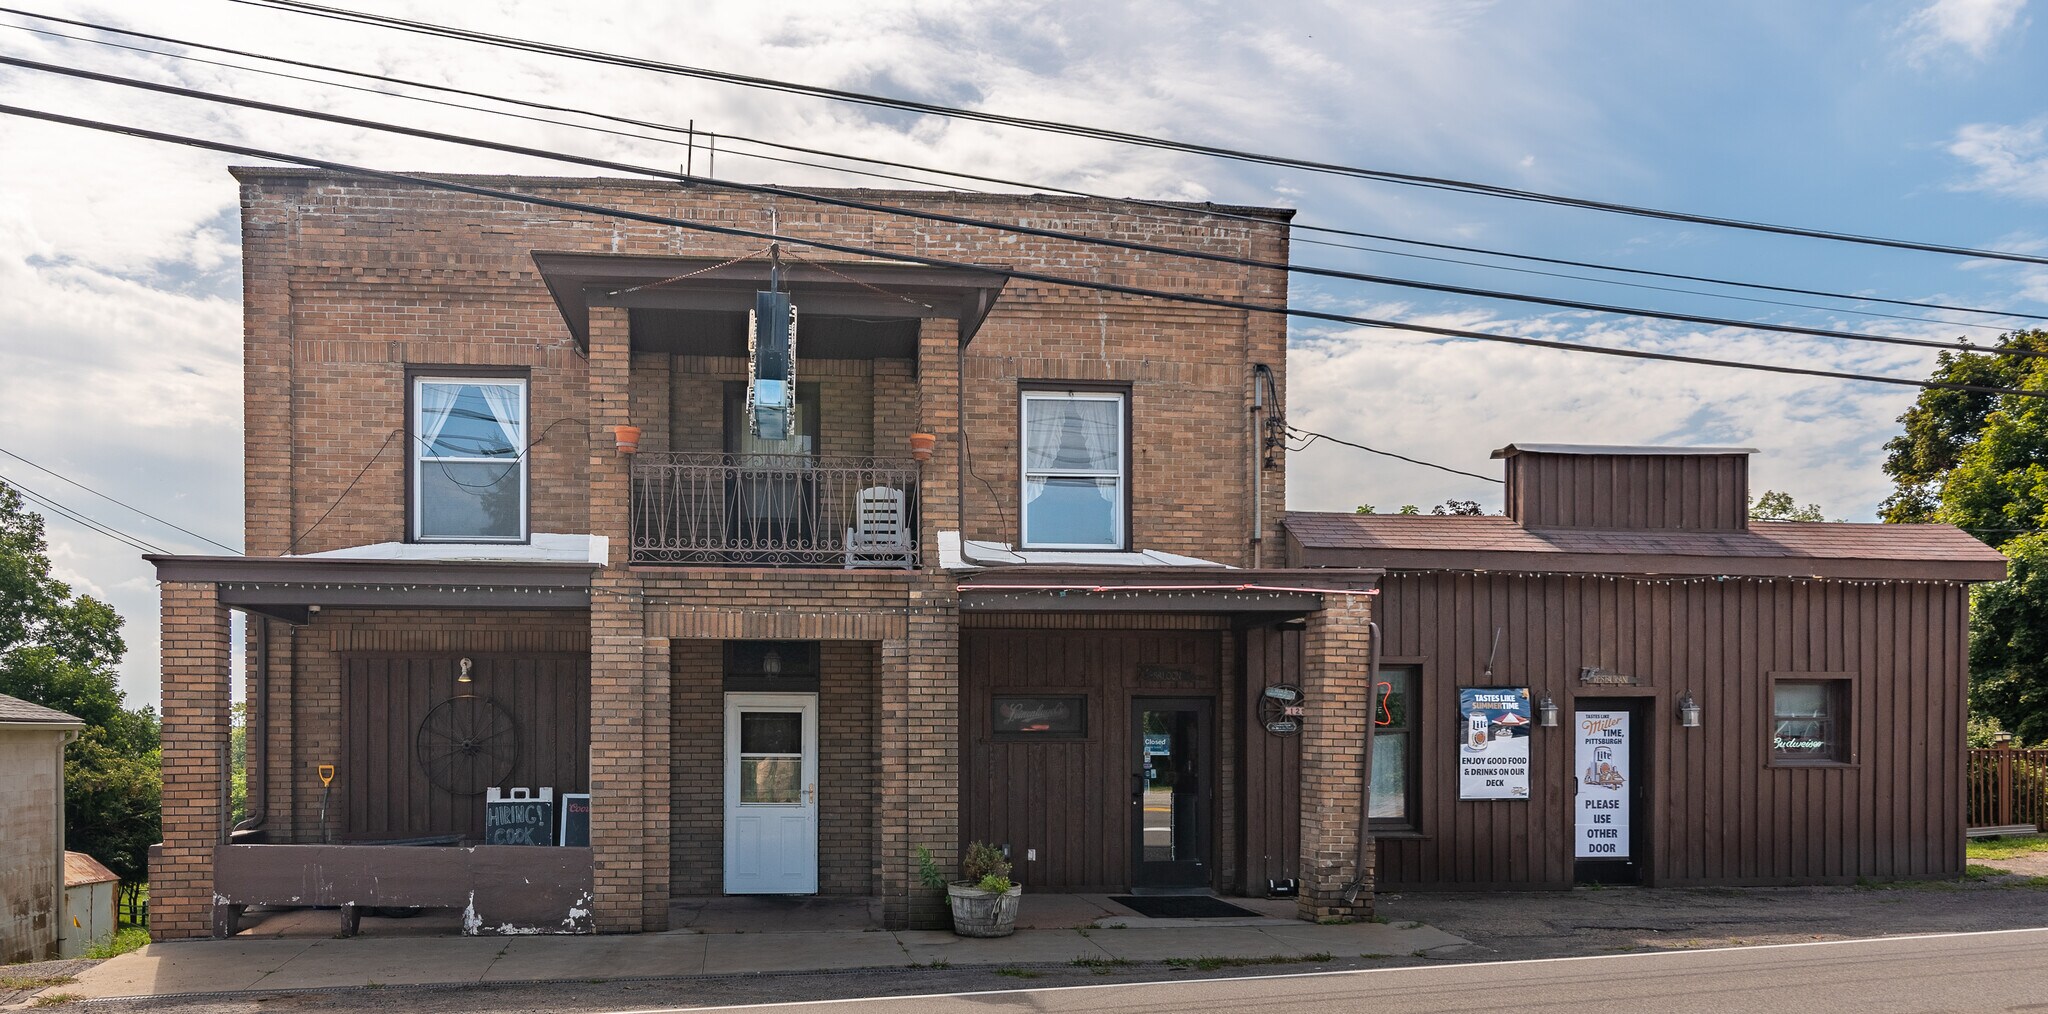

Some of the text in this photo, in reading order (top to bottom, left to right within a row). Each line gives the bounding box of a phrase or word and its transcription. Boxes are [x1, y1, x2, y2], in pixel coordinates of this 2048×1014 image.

[1474, 694, 1516, 702] TASTES LIKE
[1471, 702, 1520, 710] SUMMERTIME
[1472, 720, 1487, 731] Lite
[1582, 718, 1623, 736] Miller
[1602, 729, 1624, 738] TIME,
[1774, 737, 1825, 749] Budweiser
[1462, 757, 1527, 765] ENJOY GOOD FOOD
[1597, 751, 1612, 762] Lite
[1464, 768, 1525, 776] & DRINKS ON OUR
[1486, 779, 1504, 787] DECK
[1585, 799, 1620, 809] PLEASE
[487, 805, 544, 827] HIRING!
[1593, 814, 1611, 824] USE
[494, 827, 535, 846] COOK
[1587, 829, 1618, 838] OTHER
[1589, 843, 1616, 853] DOOR
